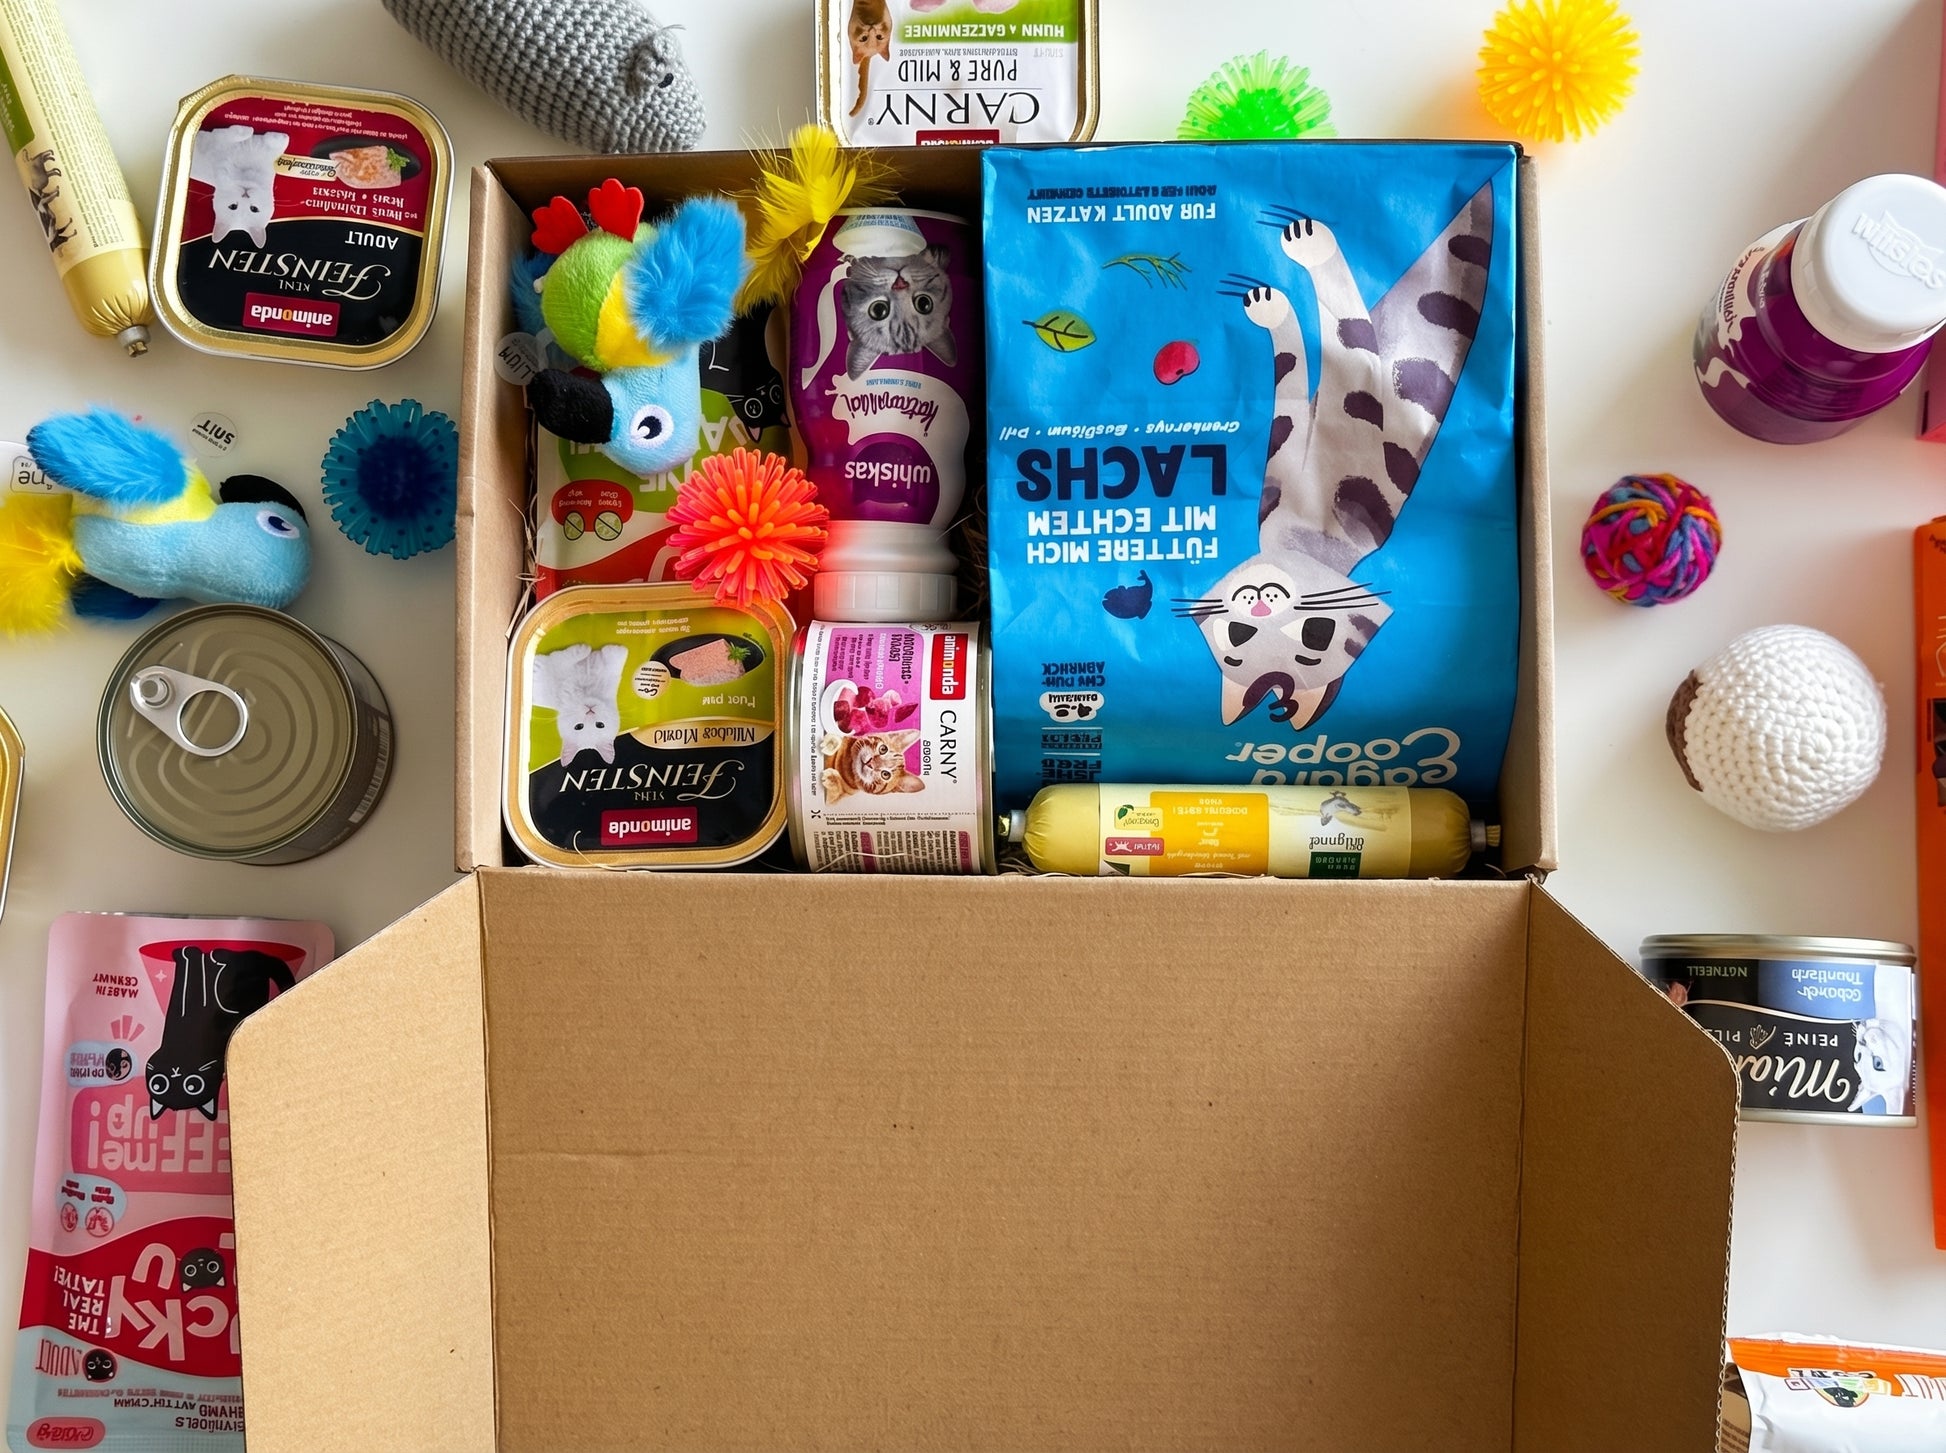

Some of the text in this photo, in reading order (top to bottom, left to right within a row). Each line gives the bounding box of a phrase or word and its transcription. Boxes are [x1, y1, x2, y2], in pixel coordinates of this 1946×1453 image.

[897, 59, 1017, 82] PURE & MILD
[876, 92, 1040, 126] CARNY
[1026, 205, 1106, 224] KATZEN
[1112, 204, 1174, 221] ADULT
[344, 230, 399, 250] ADULT
[208, 248, 391, 301] FEINSTEN
[250, 305, 333, 328] animonda
[844, 461, 931, 490] whiskas
[1015, 444, 1227, 502] LACHS
[1027, 505, 1216, 537] MIT ECHTEM
[1026, 536, 1218, 565] FÜTTERE MICH
[942, 634, 960, 696] animonda
[940, 709, 957, 778] CARNY
[558, 759, 745, 801] FEINSTEN
